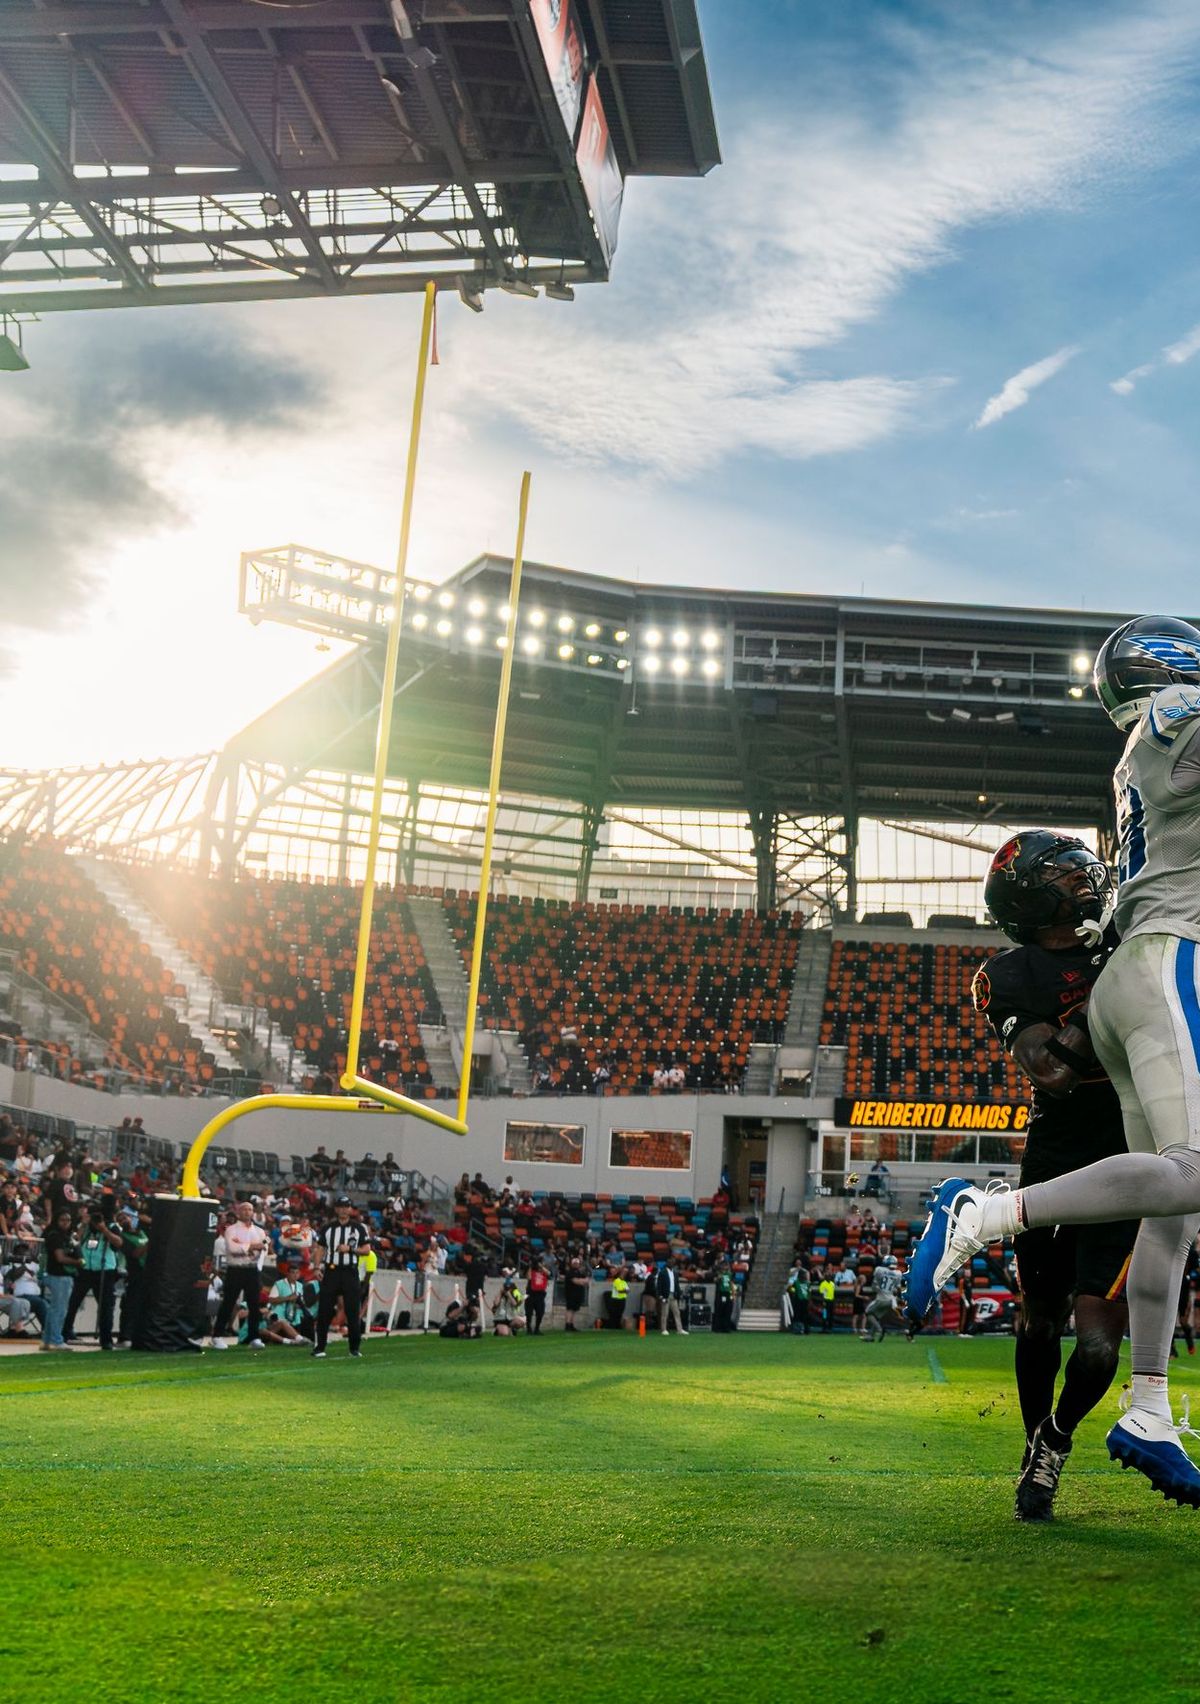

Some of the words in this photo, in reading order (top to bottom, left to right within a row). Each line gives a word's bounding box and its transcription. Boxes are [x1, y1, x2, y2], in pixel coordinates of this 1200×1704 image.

[850, 1102, 946, 1127] HERIBERTO
[948, 1104, 1011, 1129] RAMOS
[1013, 1106, 1028, 1130] &
